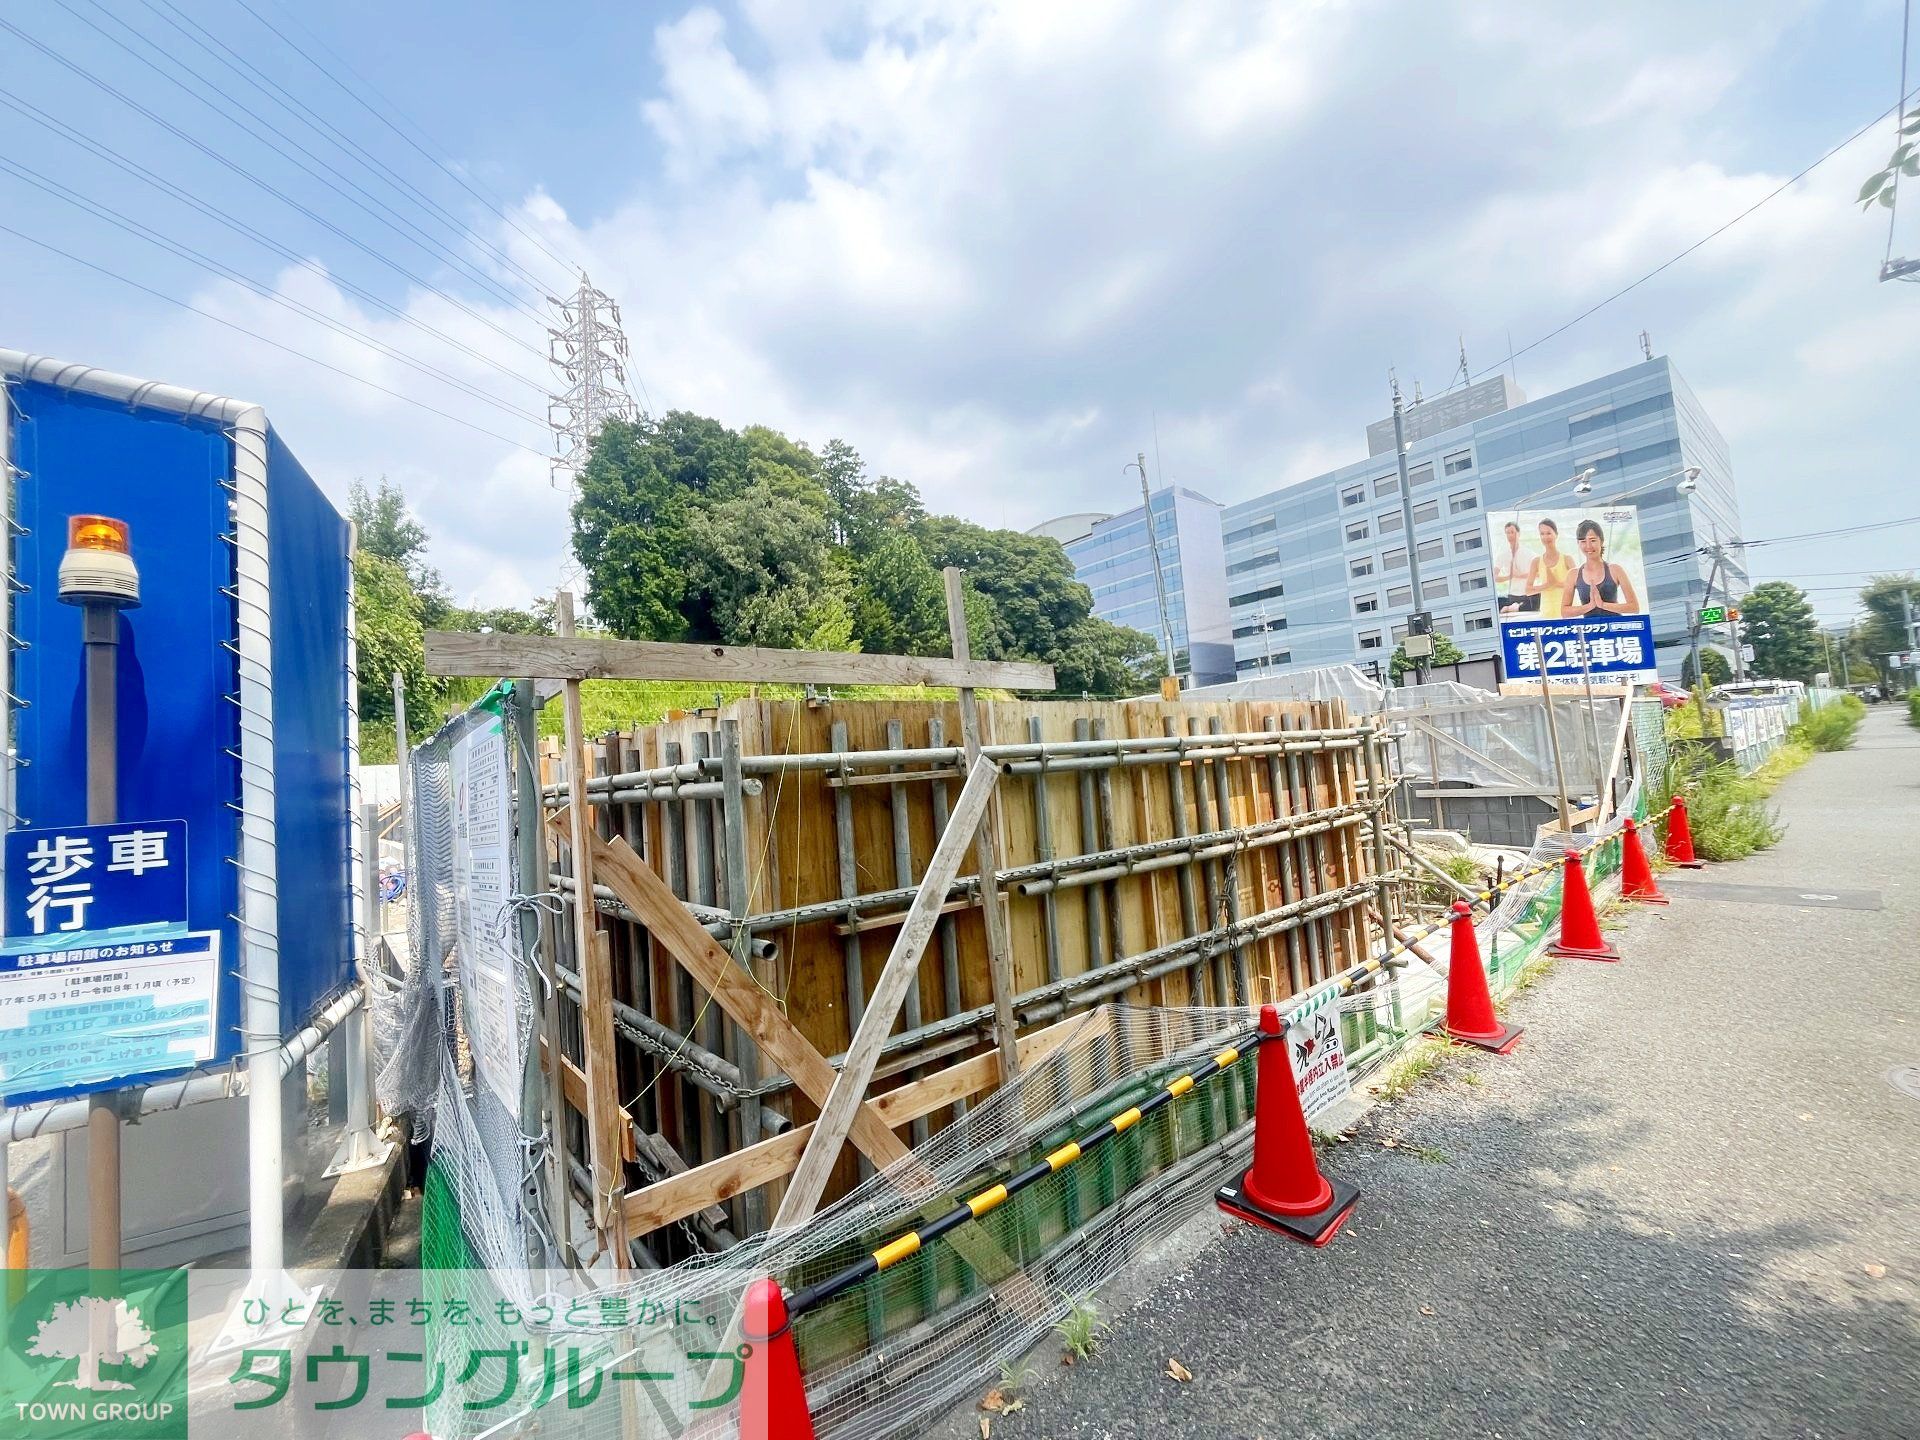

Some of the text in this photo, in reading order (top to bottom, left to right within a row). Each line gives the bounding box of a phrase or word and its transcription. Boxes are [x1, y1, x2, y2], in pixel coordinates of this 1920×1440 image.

[1516, 636, 1643, 671] 第2駐車場
[107, 830, 169, 876] 車
[17, 940, 174, 968] 駐車場閉鎖のお知らせ
